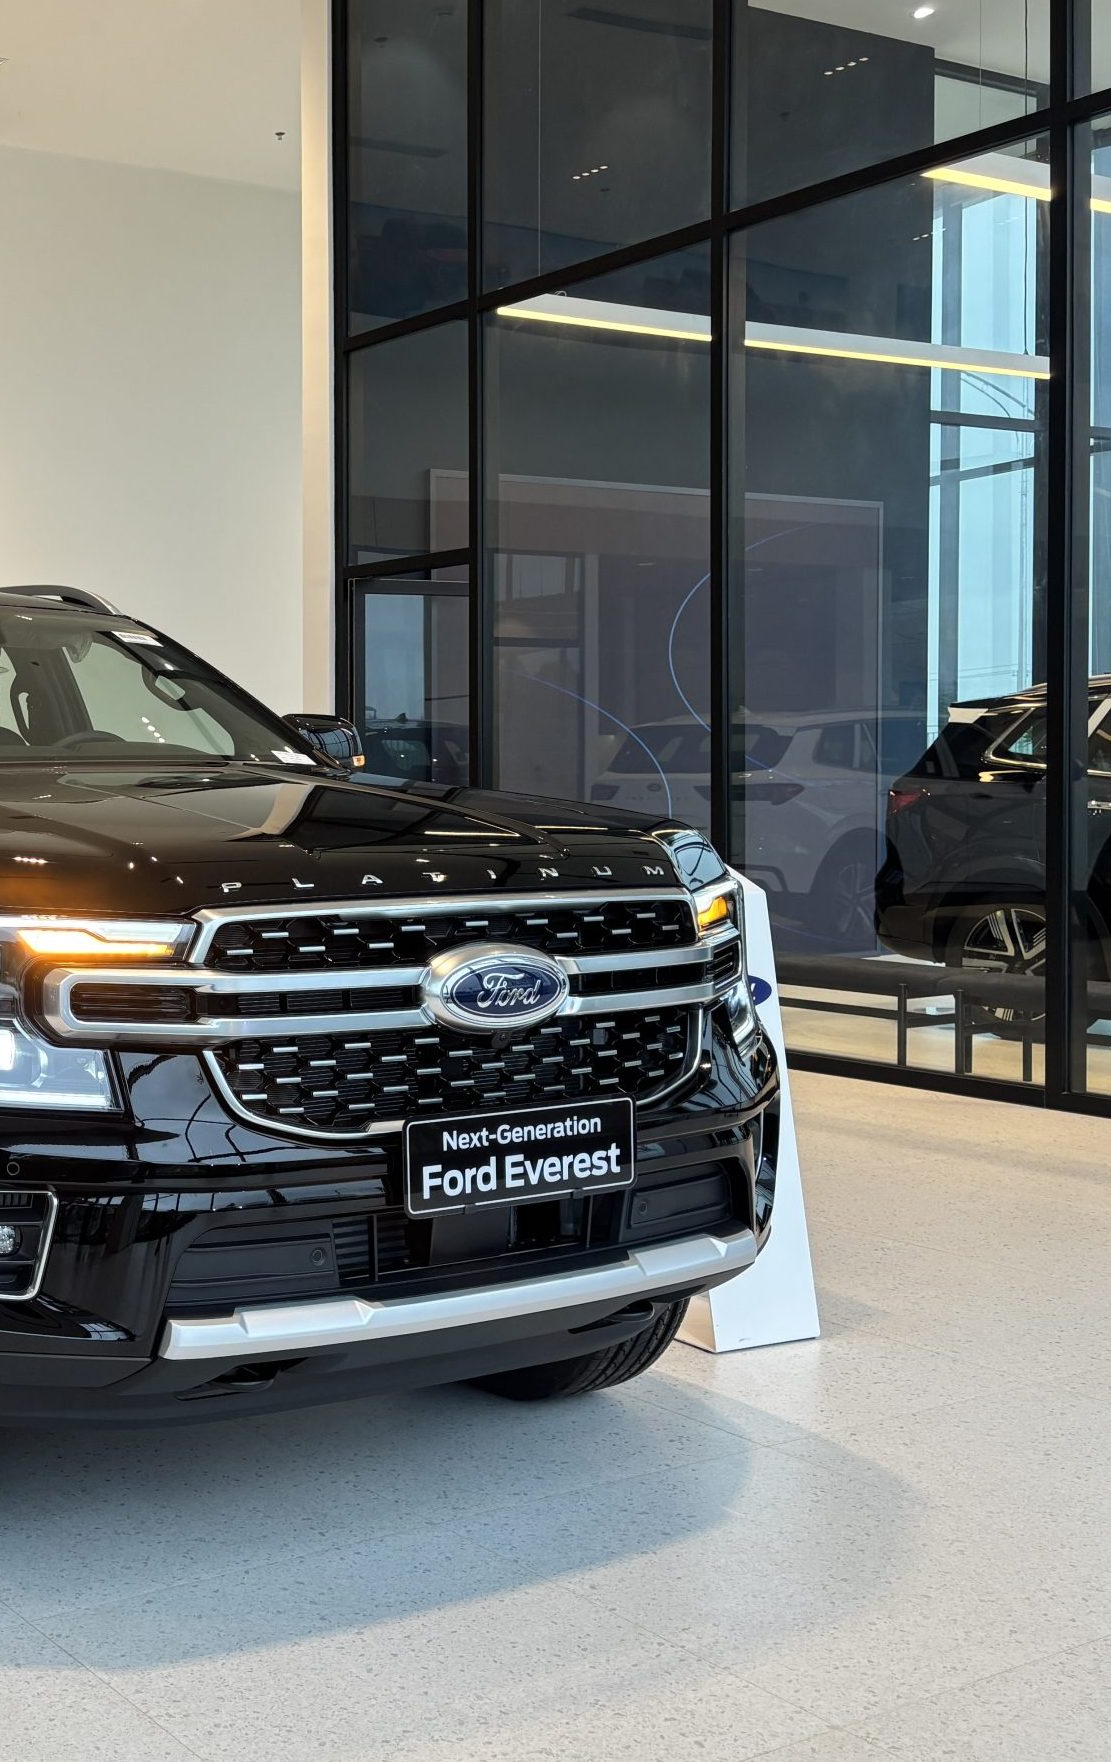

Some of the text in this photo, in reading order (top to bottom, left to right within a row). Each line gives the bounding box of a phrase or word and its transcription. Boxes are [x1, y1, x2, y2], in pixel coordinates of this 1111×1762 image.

[220, 864, 665, 893] PLATINUM
[476, 972, 542, 1008] Ford
[442, 1115, 602, 1152] Next-Generation
[422, 1142, 621, 1200] Ford Everest
